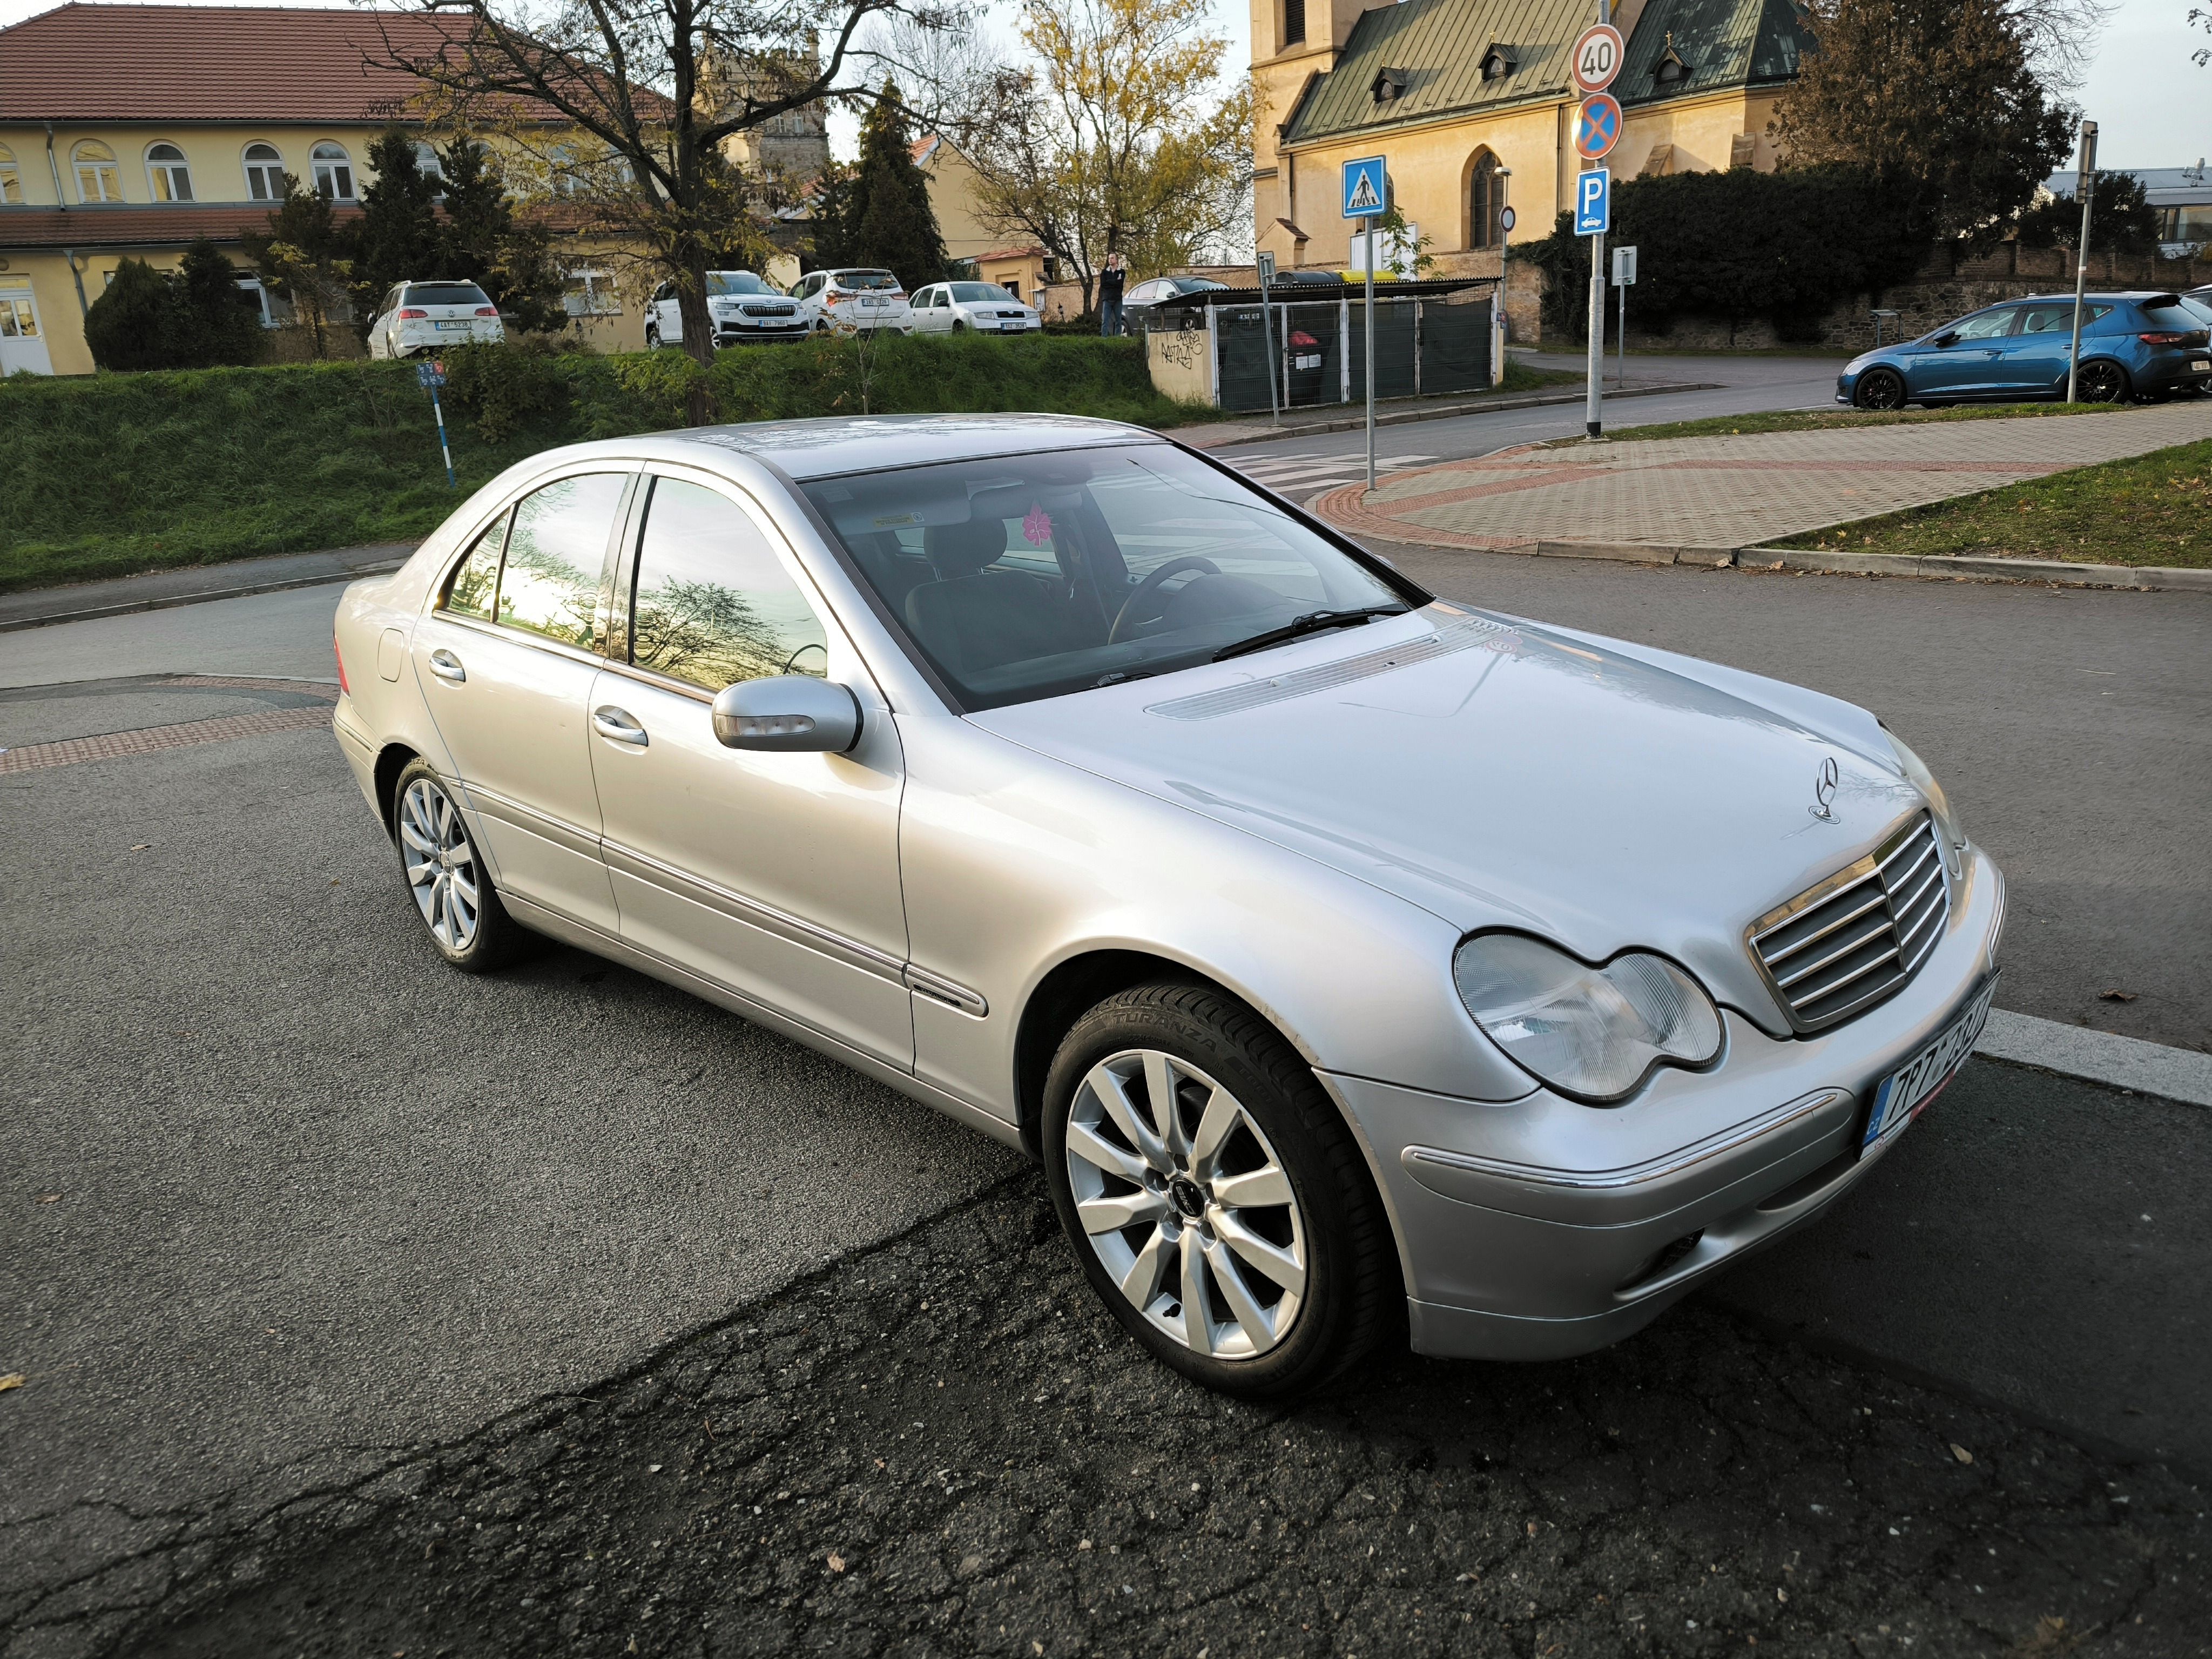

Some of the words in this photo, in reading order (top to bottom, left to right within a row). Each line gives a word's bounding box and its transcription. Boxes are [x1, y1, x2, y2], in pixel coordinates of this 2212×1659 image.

[1581, 42, 1611, 75] 40
[1583, 178, 1603, 215] P
[1113, 1013, 1217, 1053] TURANZA
[1887, 1045, 1939, 1122] 7P7
[1866, 1116, 1880, 1135] CZ
